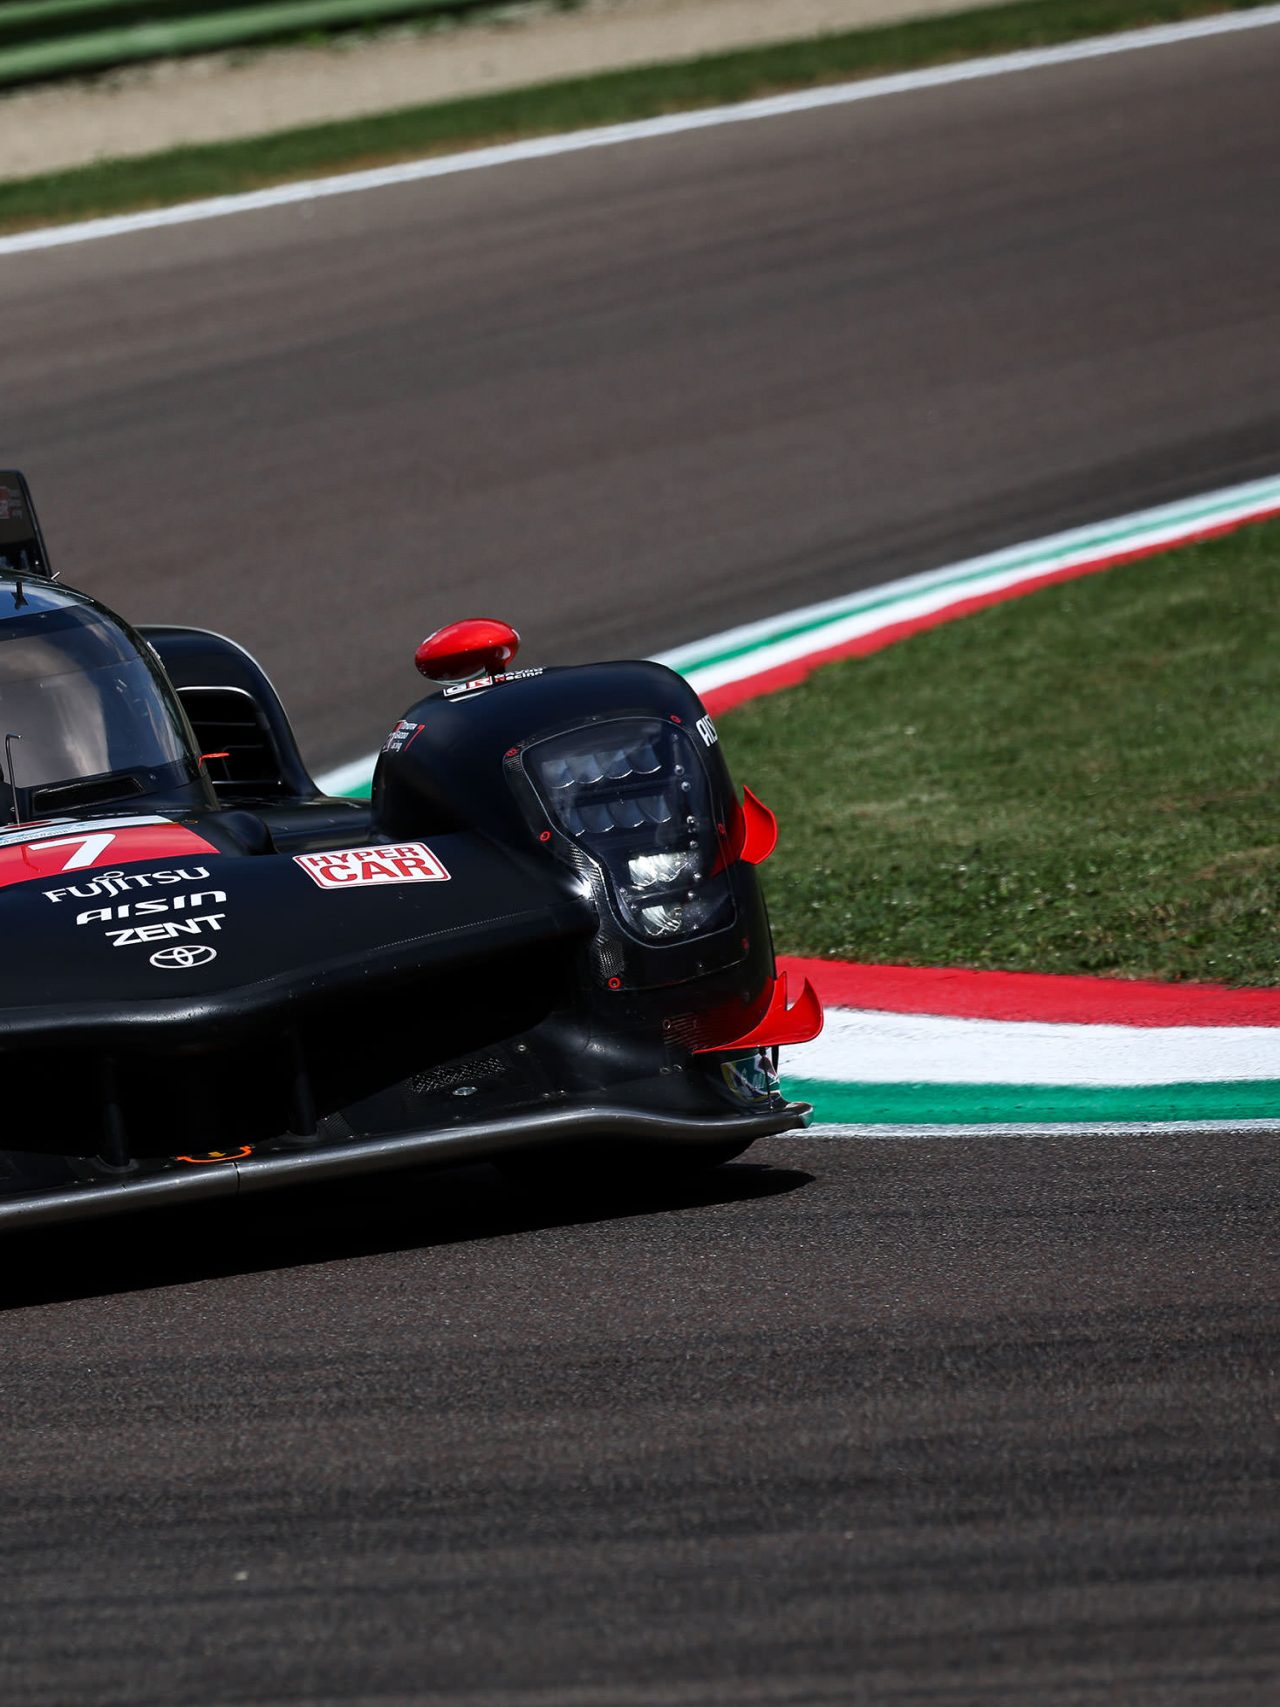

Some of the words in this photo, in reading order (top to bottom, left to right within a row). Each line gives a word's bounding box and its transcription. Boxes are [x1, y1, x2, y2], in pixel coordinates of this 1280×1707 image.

[28, 833, 117, 871] 7
[308, 846, 420, 867] HYPER
[42, 866, 211, 903] FUJITSU
[319, 857, 436, 883] CAR
[76, 890, 227, 925] AISIN
[105, 913, 226, 947] ZENT
